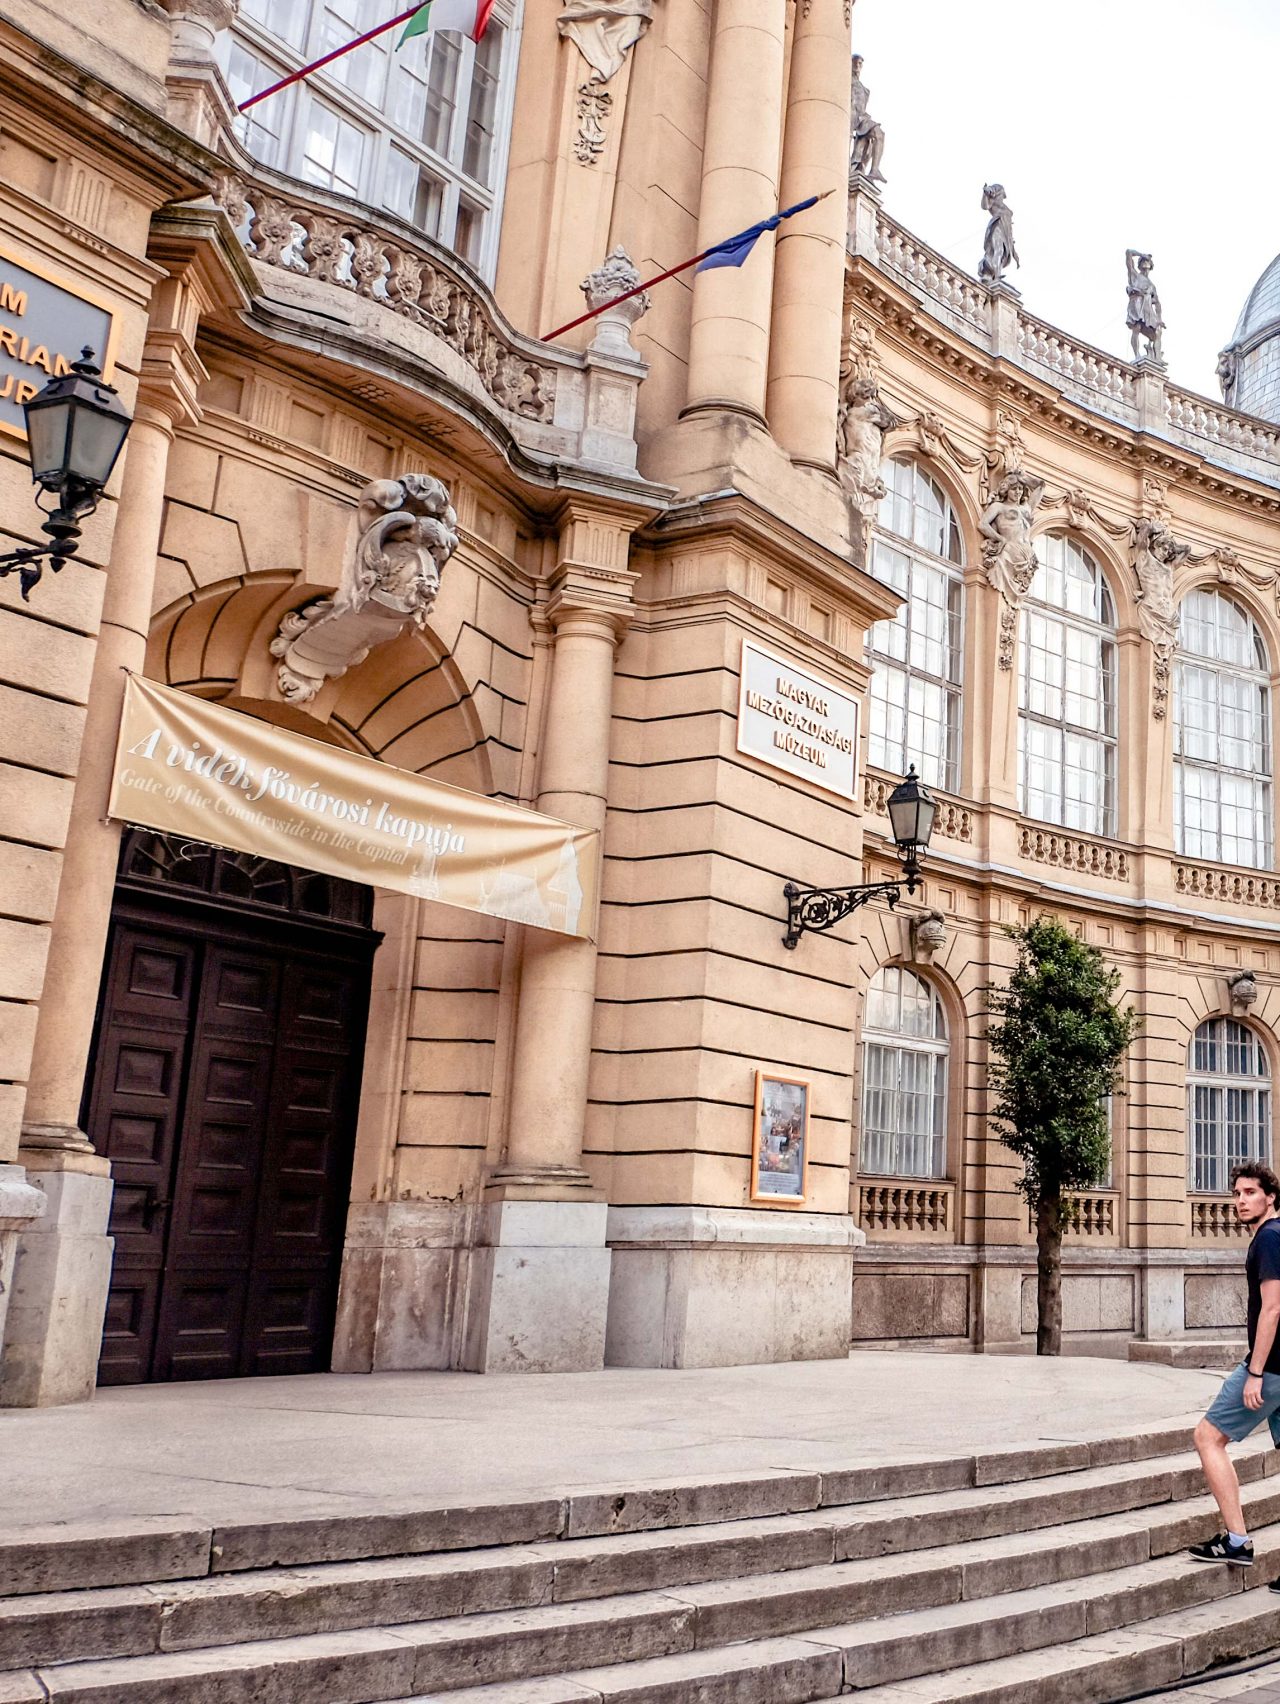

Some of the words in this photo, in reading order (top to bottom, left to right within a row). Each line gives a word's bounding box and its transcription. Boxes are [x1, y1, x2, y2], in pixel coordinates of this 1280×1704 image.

[747, 690, 852, 754] MEZŐGAZDASÁGI
[777, 677, 829, 717] MAGYAR
[774, 730, 828, 768] MÚZEUM
[120, 768, 162, 793] Gate
[164, 782, 187, 804] of
[185, 786, 212, 809] the
[214, 797, 310, 837] Countryside
[311, 825, 328, 843] in
[329, 831, 355, 850] the
[356, 838, 409, 866] Capital
[127, 728, 162, 761] A
[166, 741, 254, 790] vidék
[246, 766, 373, 826] fővárosi
[374, 801, 465, 856] kapuja
[1211, 1543, 1226, 1556] N
